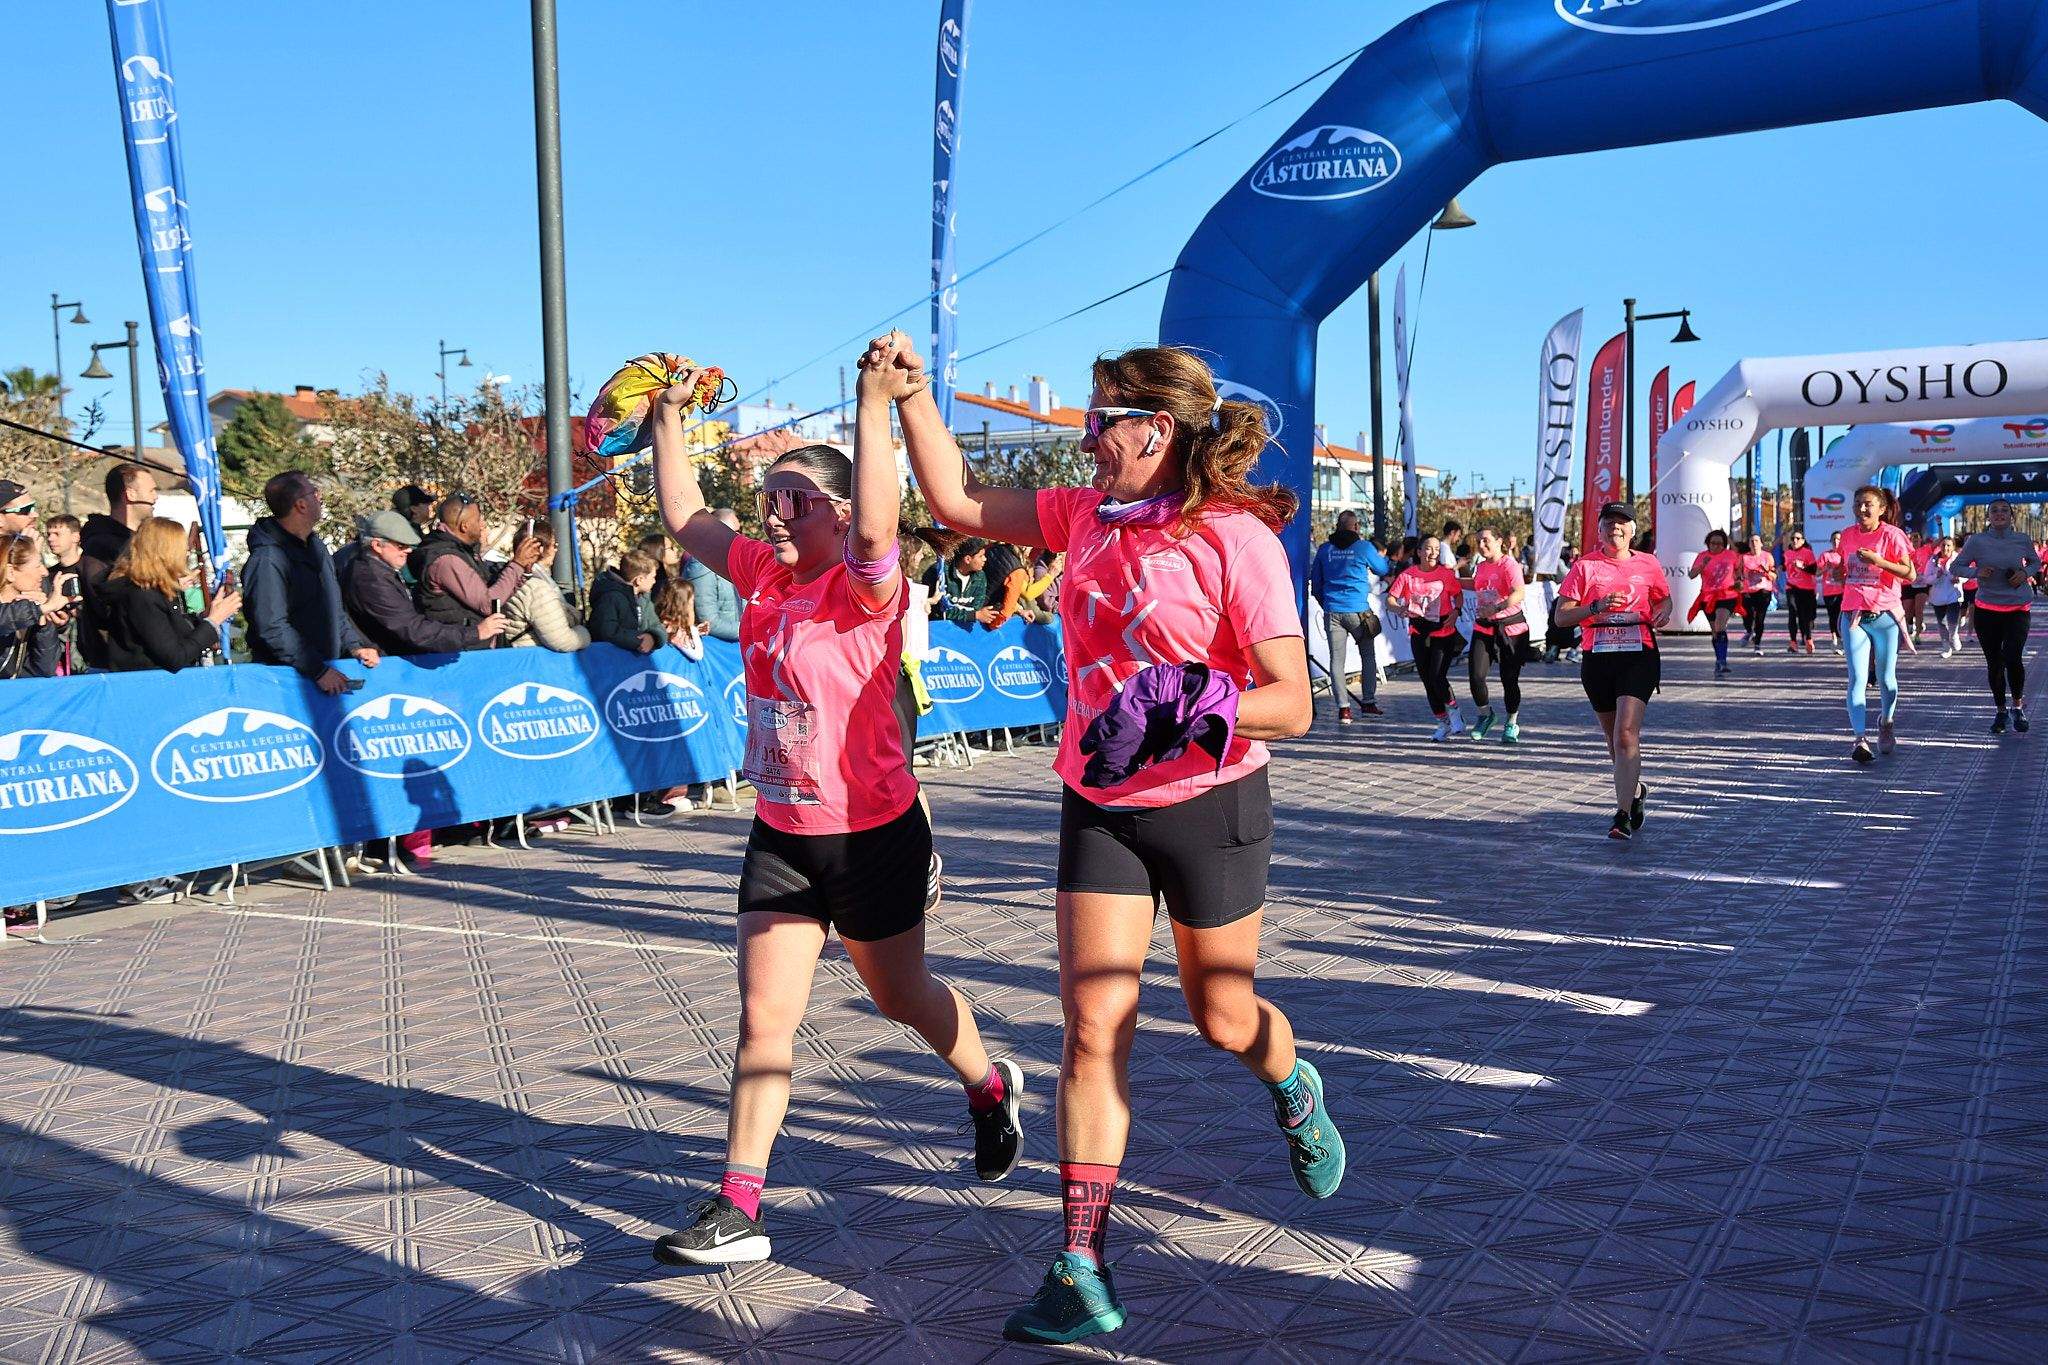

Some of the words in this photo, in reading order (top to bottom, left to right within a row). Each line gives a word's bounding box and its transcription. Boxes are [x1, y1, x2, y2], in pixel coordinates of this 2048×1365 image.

[1282, 151, 1327, 162] CENTRAL
[1332, 146, 1384, 156] LECHERA
[1258, 157, 1389, 187] ASTURIANA
[1801, 359, 2008, 407] OYSHO
[1597, 366, 1614, 465] Santander
[1687, 418, 1743, 431] OYSHO
[1539, 353, 1575, 534] OYSHO
[1954, 472, 2048, 484] VOLV
[1661, 492, 1713, 505] OYSHO
[925, 672, 982, 691] STURIANA
[995, 665, 1049, 687] ASTURIANA
[616, 699, 702, 728] ASTURIANA
[491, 713, 593, 745] ASTURIANA
[191, 739, 247, 754] CENTRAL
[252, 732, 307, 747] LECHERA
[349, 728, 464, 762] ASTURIANA
[49, 755, 114, 771] LECHERA
[169, 744, 318, 786] ASTURIANA
